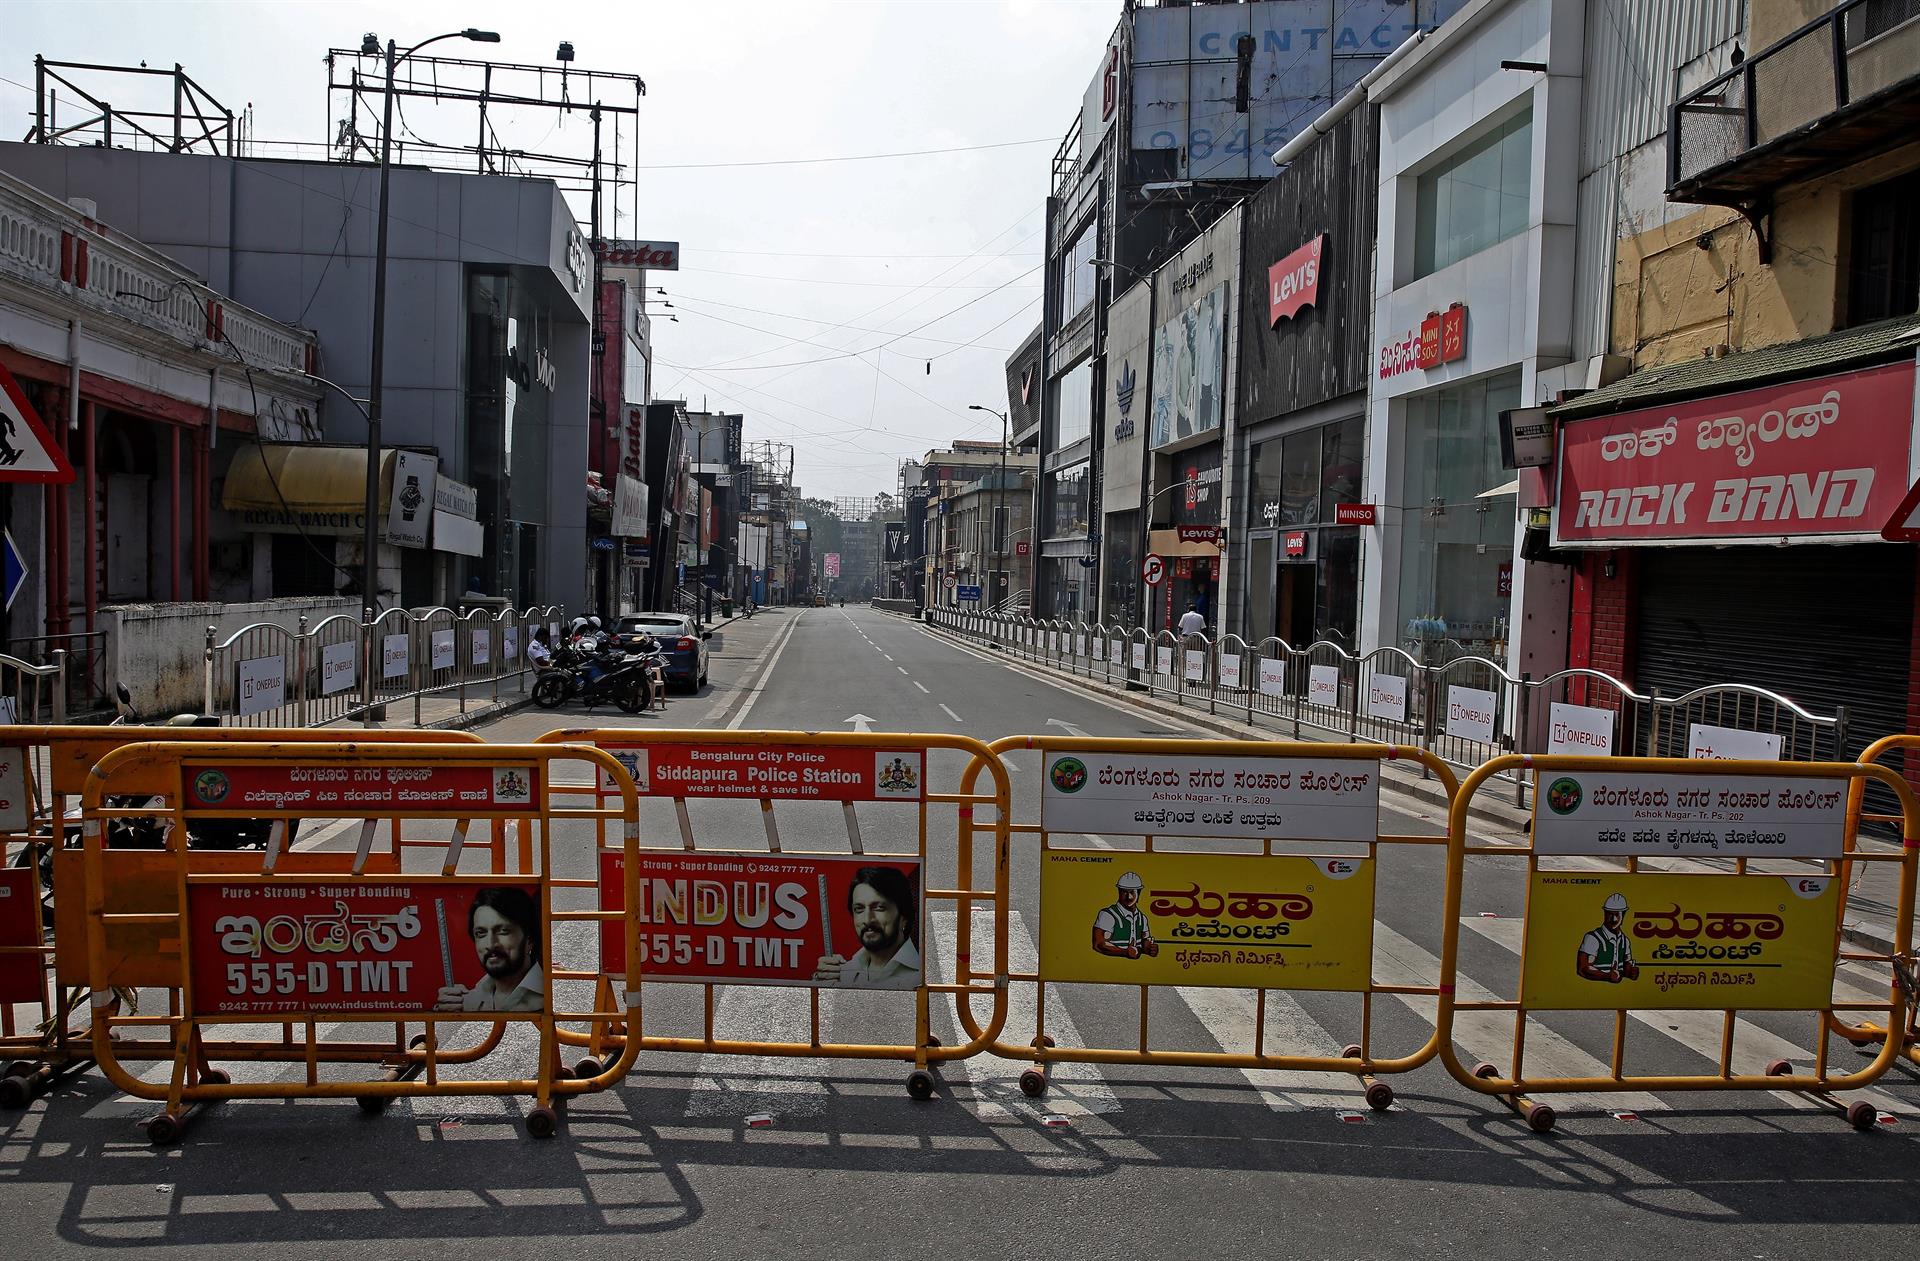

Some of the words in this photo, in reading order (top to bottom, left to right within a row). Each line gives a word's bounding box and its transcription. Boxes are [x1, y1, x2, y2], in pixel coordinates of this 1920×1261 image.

[1422, 328, 1438, 344] MINI
[1574, 482, 1696, 529] ROCK
[1706, 467, 1875, 523] BAND
[301, 511, 349, 527] WATCH
[1339, 510, 1372, 519] MINISO
[334, 660, 352, 673] ONEPLUS
[256, 677, 281, 691] ONEPLUS
[1316, 681, 1335, 693] ONEPLUS
[1379, 693, 1403, 707] ONEPLUS
[1460, 707, 1491, 726] ONEPLUS
[1567, 731, 1607, 748] ONEPLUS
[690, 750, 754, 762] Bengaluru
[758, 752, 783, 763] City
[787, 752, 826, 763] Police
[656, 765, 738, 783] Siddapura
[748, 767, 798, 782] Police
[803, 768, 862, 784] Station
[1099, 765, 1180, 787] ಬೆಂಗಳೂರು
[1189, 768, 1225, 787] ನಗರ
[1234, 771, 1291, 789] ಸಂಚಾರ
[687, 785, 715, 793] wear
[718, 784, 757, 793] helmet
[772, 786, 798, 794] save
[801, 786, 819, 795] life
[1152, 791, 1183, 801] Ashok
[1185, 793, 1213, 803] Nagar
[1222, 795, 1233, 803] Tr.
[1236, 795, 1250, 804] Ps.
[1254, 796, 1271, 805] 209
[1593, 785, 1669, 807] ಬೆಂಗಳೂರು
[1677, 788, 1710, 807] ನಗರ
[1717, 789, 1771, 809] ಸಂಚಾರ
[1634, 810, 1662, 819] Ashok
[1664, 811, 1691, 820] Nagar
[1711, 812, 1725, 820] Ps.
[1729, 813, 1744, 821] 202
[1598, 829, 1626, 843] ಪದೇ
[1632, 829, 1660, 843] ಪದೇ
[1051, 855, 1078, 863] MAHA
[1080, 856, 1114, 864] CEMENT
[643, 860, 672, 871] Strong
[680, 861, 705, 872] Super
[707, 862, 744, 873] Bonding
[758, 864, 779, 872] 9242
[781, 865, 797, 873] 777
[799, 865, 815, 874] 777
[1542, 877, 1568, 885] MAHA
[222, 887, 250, 899] Pure
[264, 886, 306, 899] Strong
[319, 886, 355, 899] Super
[359, 886, 411, 899] Bonding
[1149, 881, 1314, 920] ಮಹಾ
[1632, 902, 1784, 940] ಮಹಾ
[1171, 919, 1290, 941] ಸಿಮೆಂಟ್
[732, 936, 804, 969] TMT
[1651, 940, 1762, 960] ಸಿಮೆಂಟ್
[227, 961, 329, 995] 555-D
[336, 961, 414, 993] TMT
[219, 1002, 249, 1011] 9242
[252, 1002, 274, 1011] 777
[277, 1001, 299, 1011] 777
[309, 1001, 423, 1010] www.industmt.com
